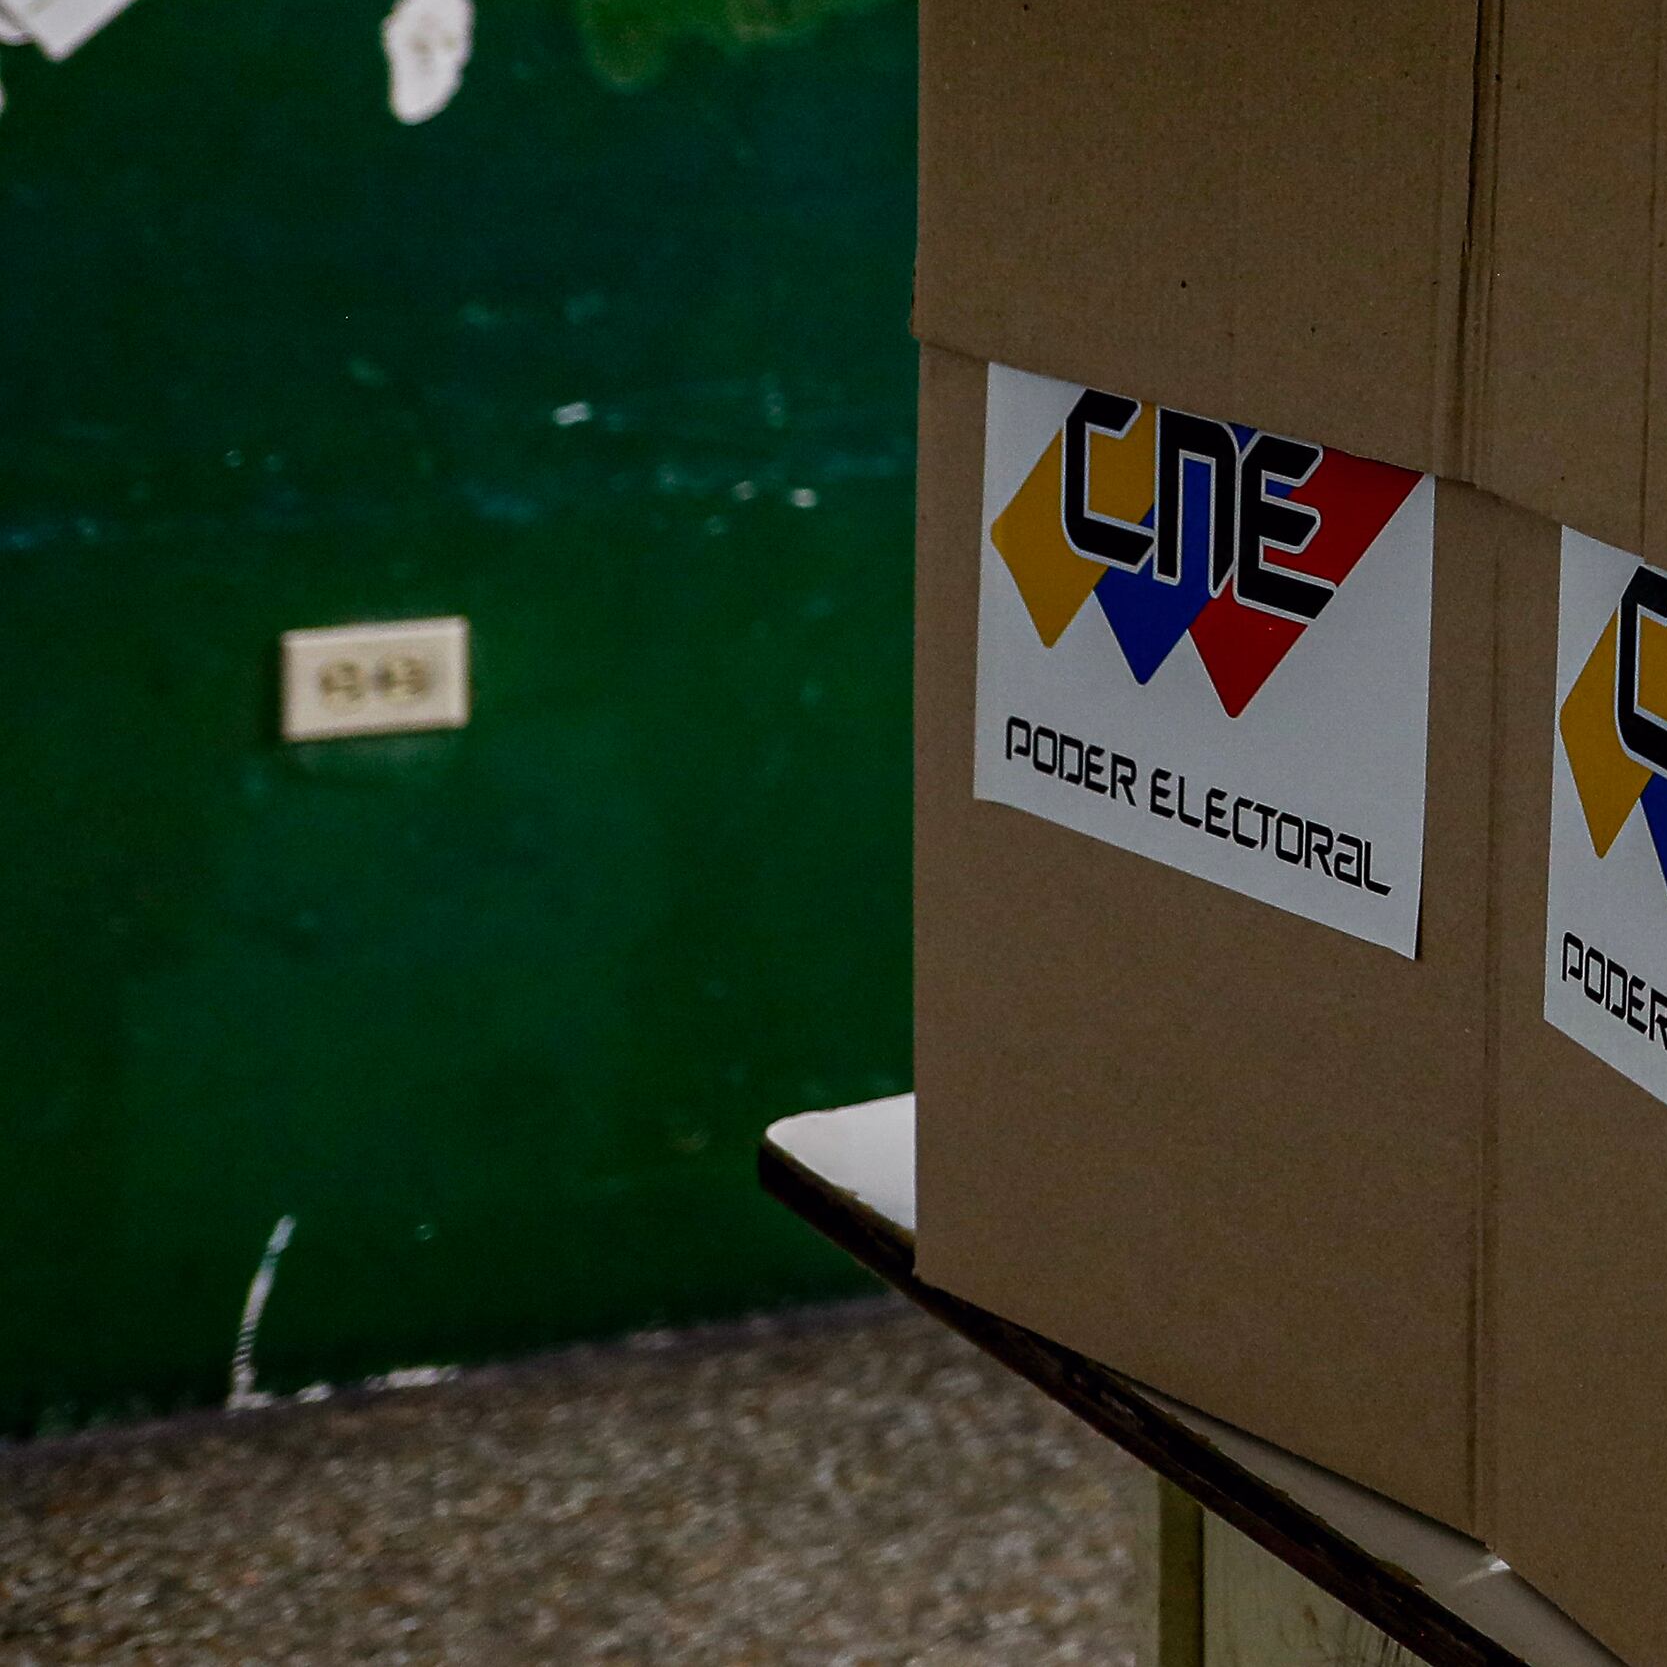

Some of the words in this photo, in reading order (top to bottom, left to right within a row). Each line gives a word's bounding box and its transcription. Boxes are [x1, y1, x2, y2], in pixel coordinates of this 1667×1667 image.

[1060, 387, 1337, 623] CNE
[1004, 716, 1138, 807] PODER
[1149, 767, 1392, 896] ELECTORAL
